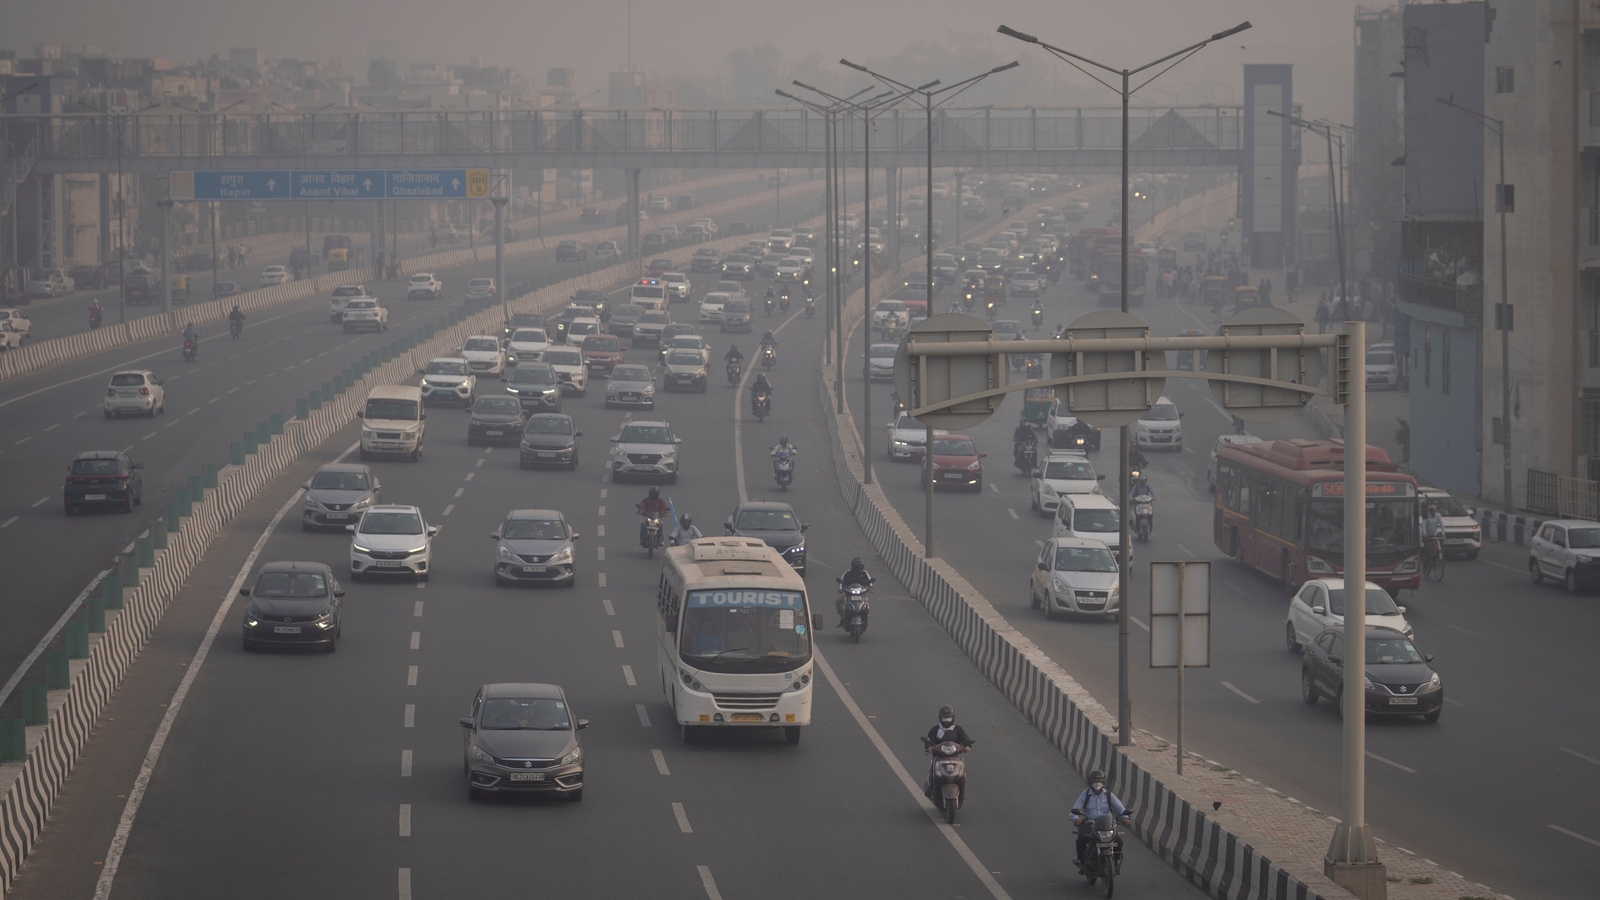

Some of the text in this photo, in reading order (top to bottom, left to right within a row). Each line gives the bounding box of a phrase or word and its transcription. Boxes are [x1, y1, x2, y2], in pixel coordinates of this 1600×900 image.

[331, 171, 355, 185] विहार
[472, 176, 485, 184] NH
[220, 187, 251, 198] Hapur
[300, 187, 359, 196] Anand Vihar
[393, 187, 443, 196] Ghaziabad
[476, 185, 482, 193] 9
[692, 592, 799, 606] TOURIST
